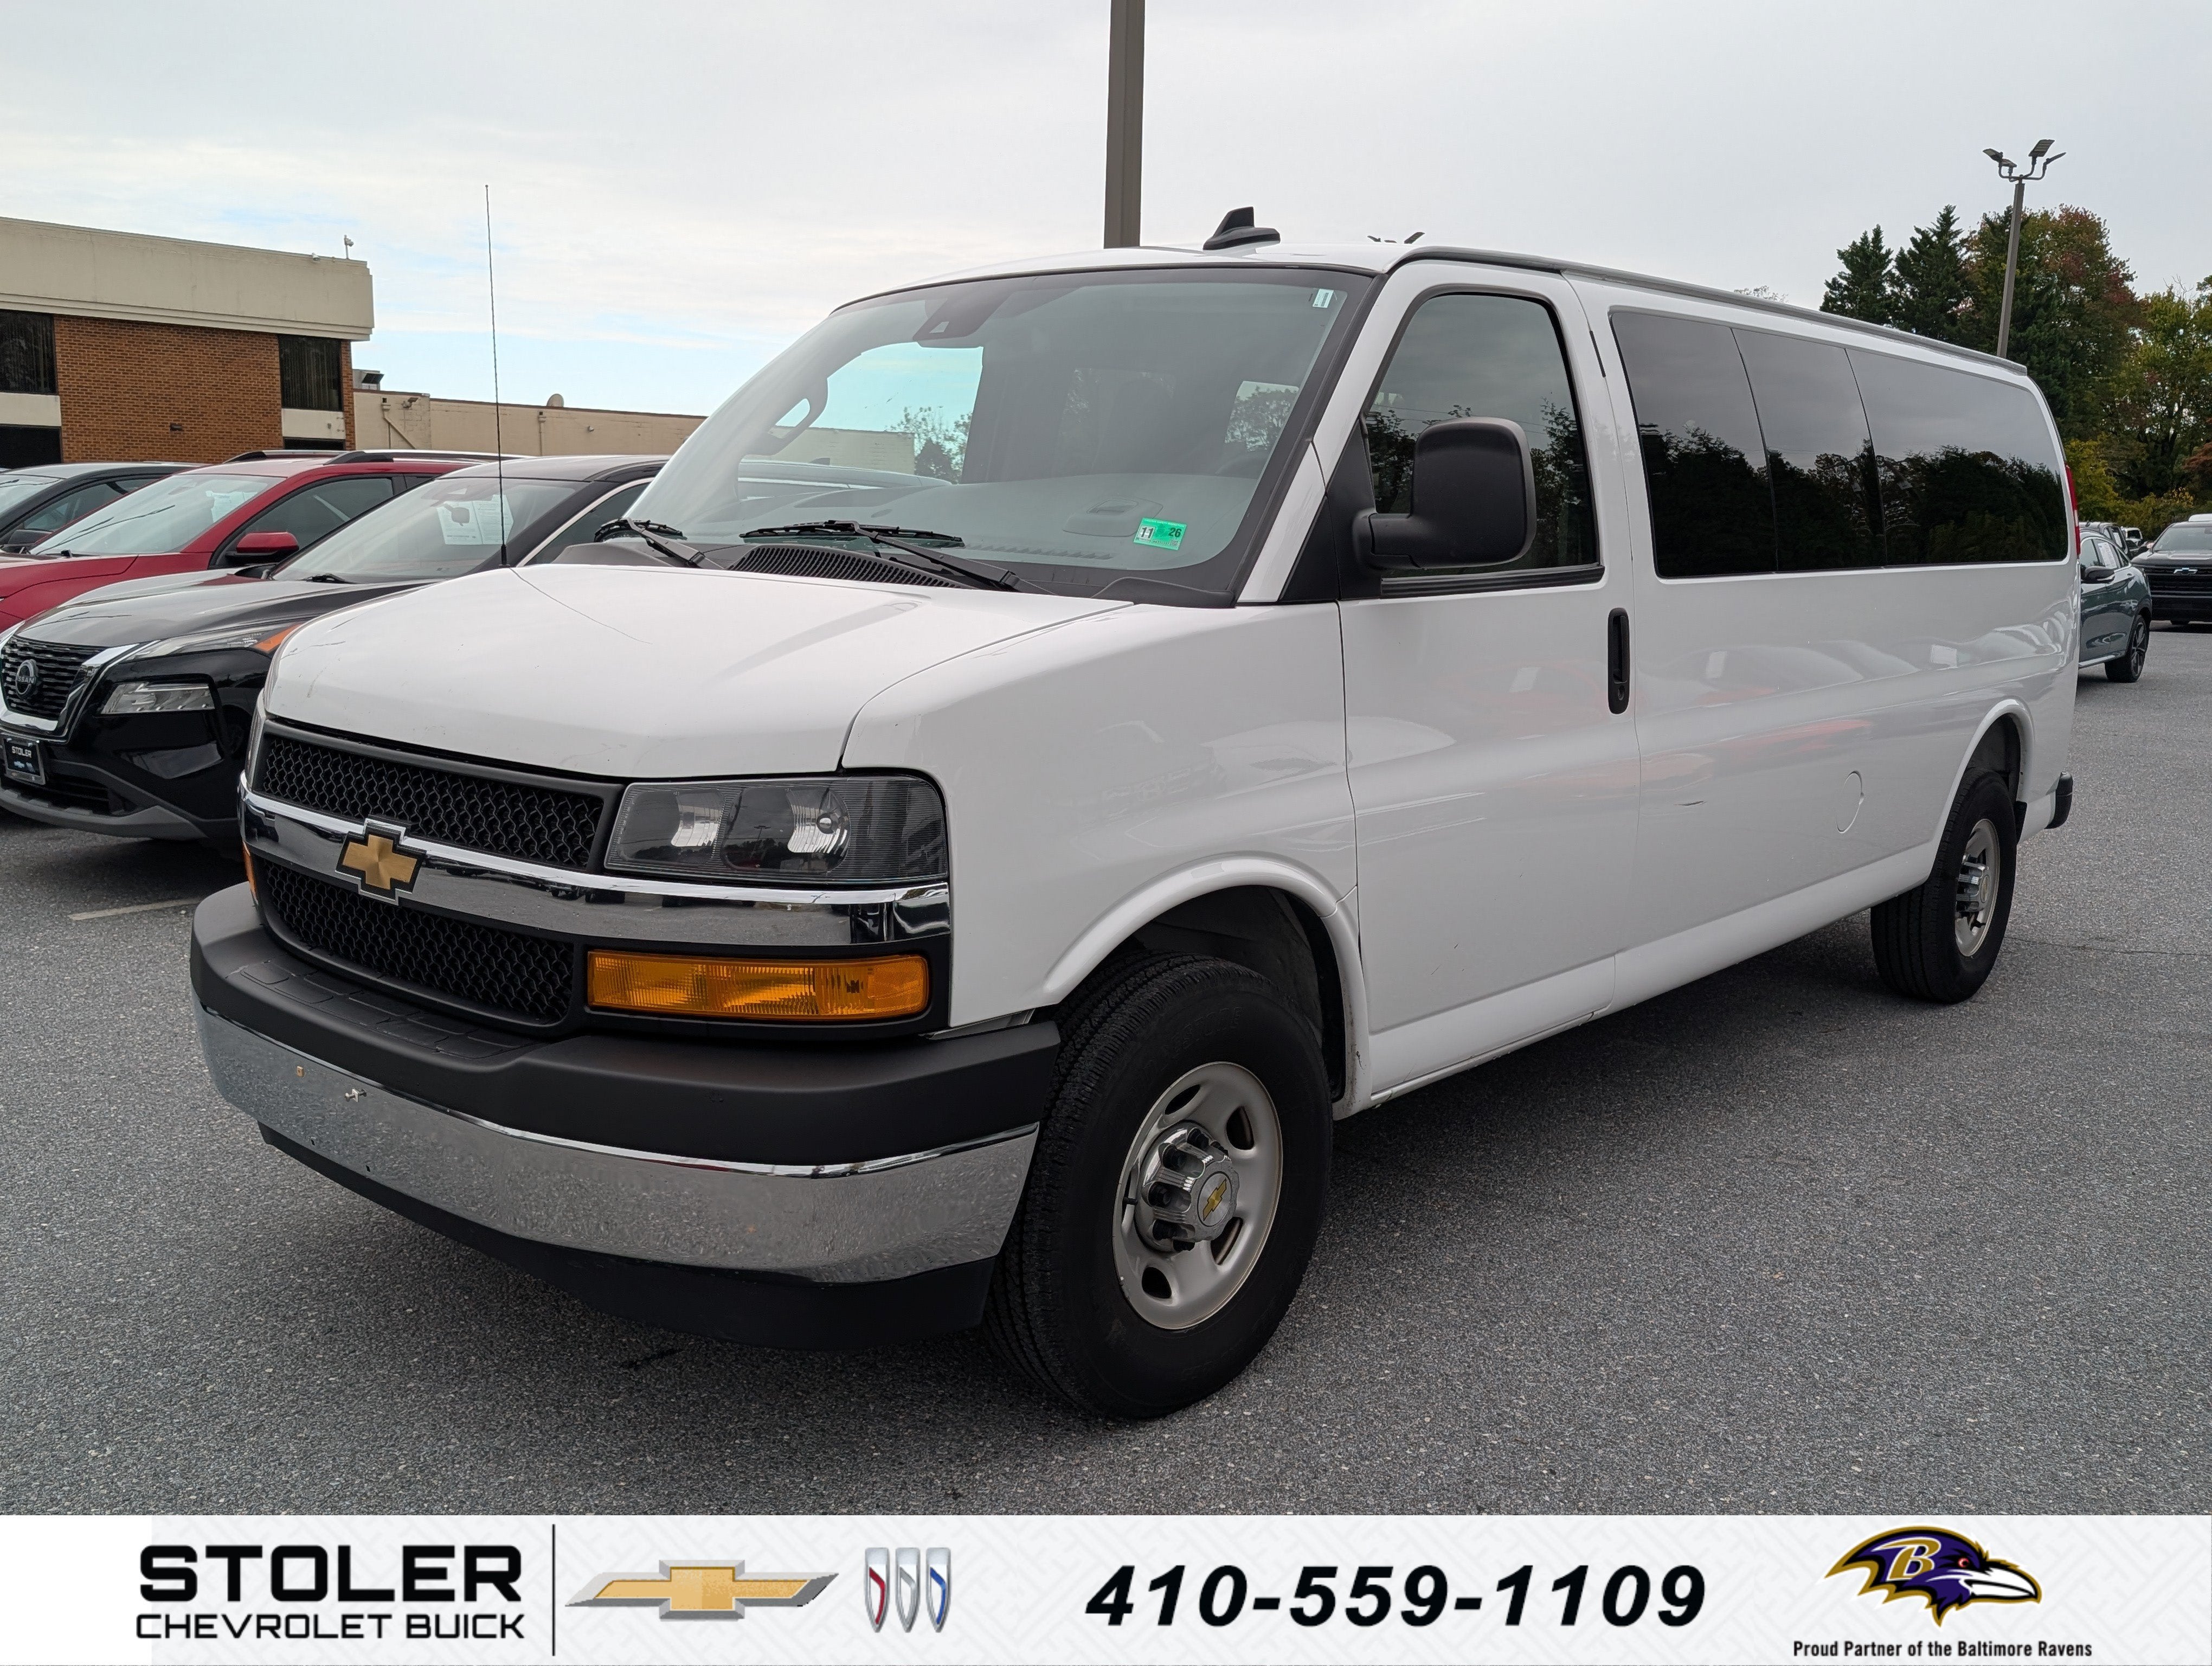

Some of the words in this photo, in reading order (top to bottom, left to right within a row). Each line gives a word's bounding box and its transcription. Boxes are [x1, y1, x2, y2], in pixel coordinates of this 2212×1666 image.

[1141, 527, 1154, 539] 11
[1168, 527, 1182, 538] 26
[11, 746, 32, 758] STOLER
